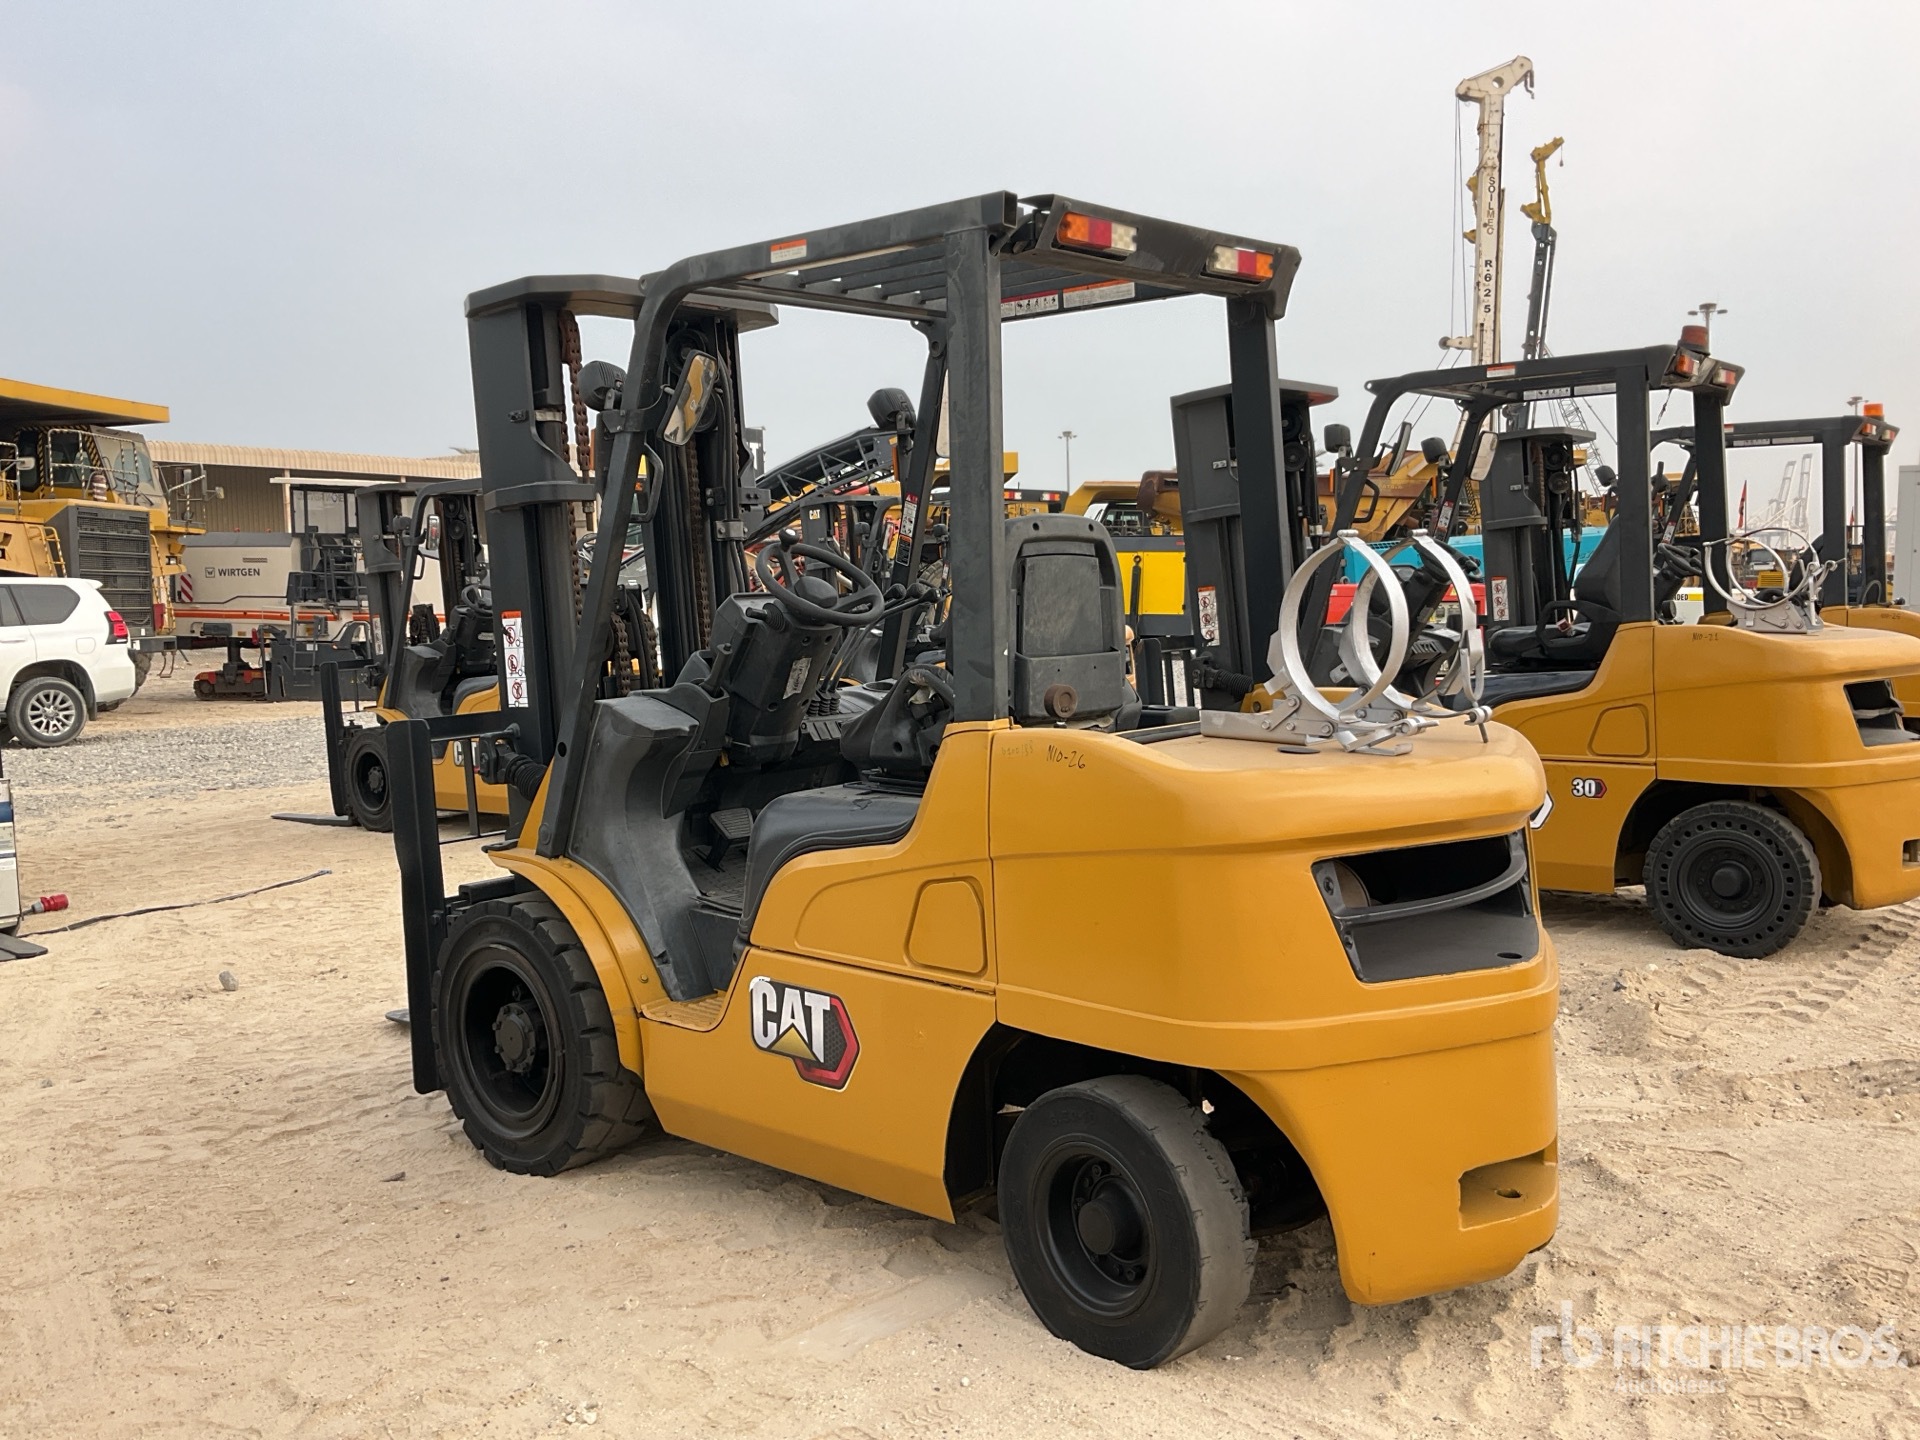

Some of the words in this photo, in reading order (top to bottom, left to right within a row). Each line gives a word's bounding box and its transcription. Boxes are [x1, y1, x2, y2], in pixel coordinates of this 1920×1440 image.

[1487, 176, 1496, 235] SOILMEC
[1483, 259, 1493, 314] R-625
[809, 509, 821, 520] CAT
[218, 568, 261, 577] WIRTGEN
[453, 740, 478, 767] CT
[1572, 778, 1597, 798] 30
[752, 979, 831, 1064] CAT
